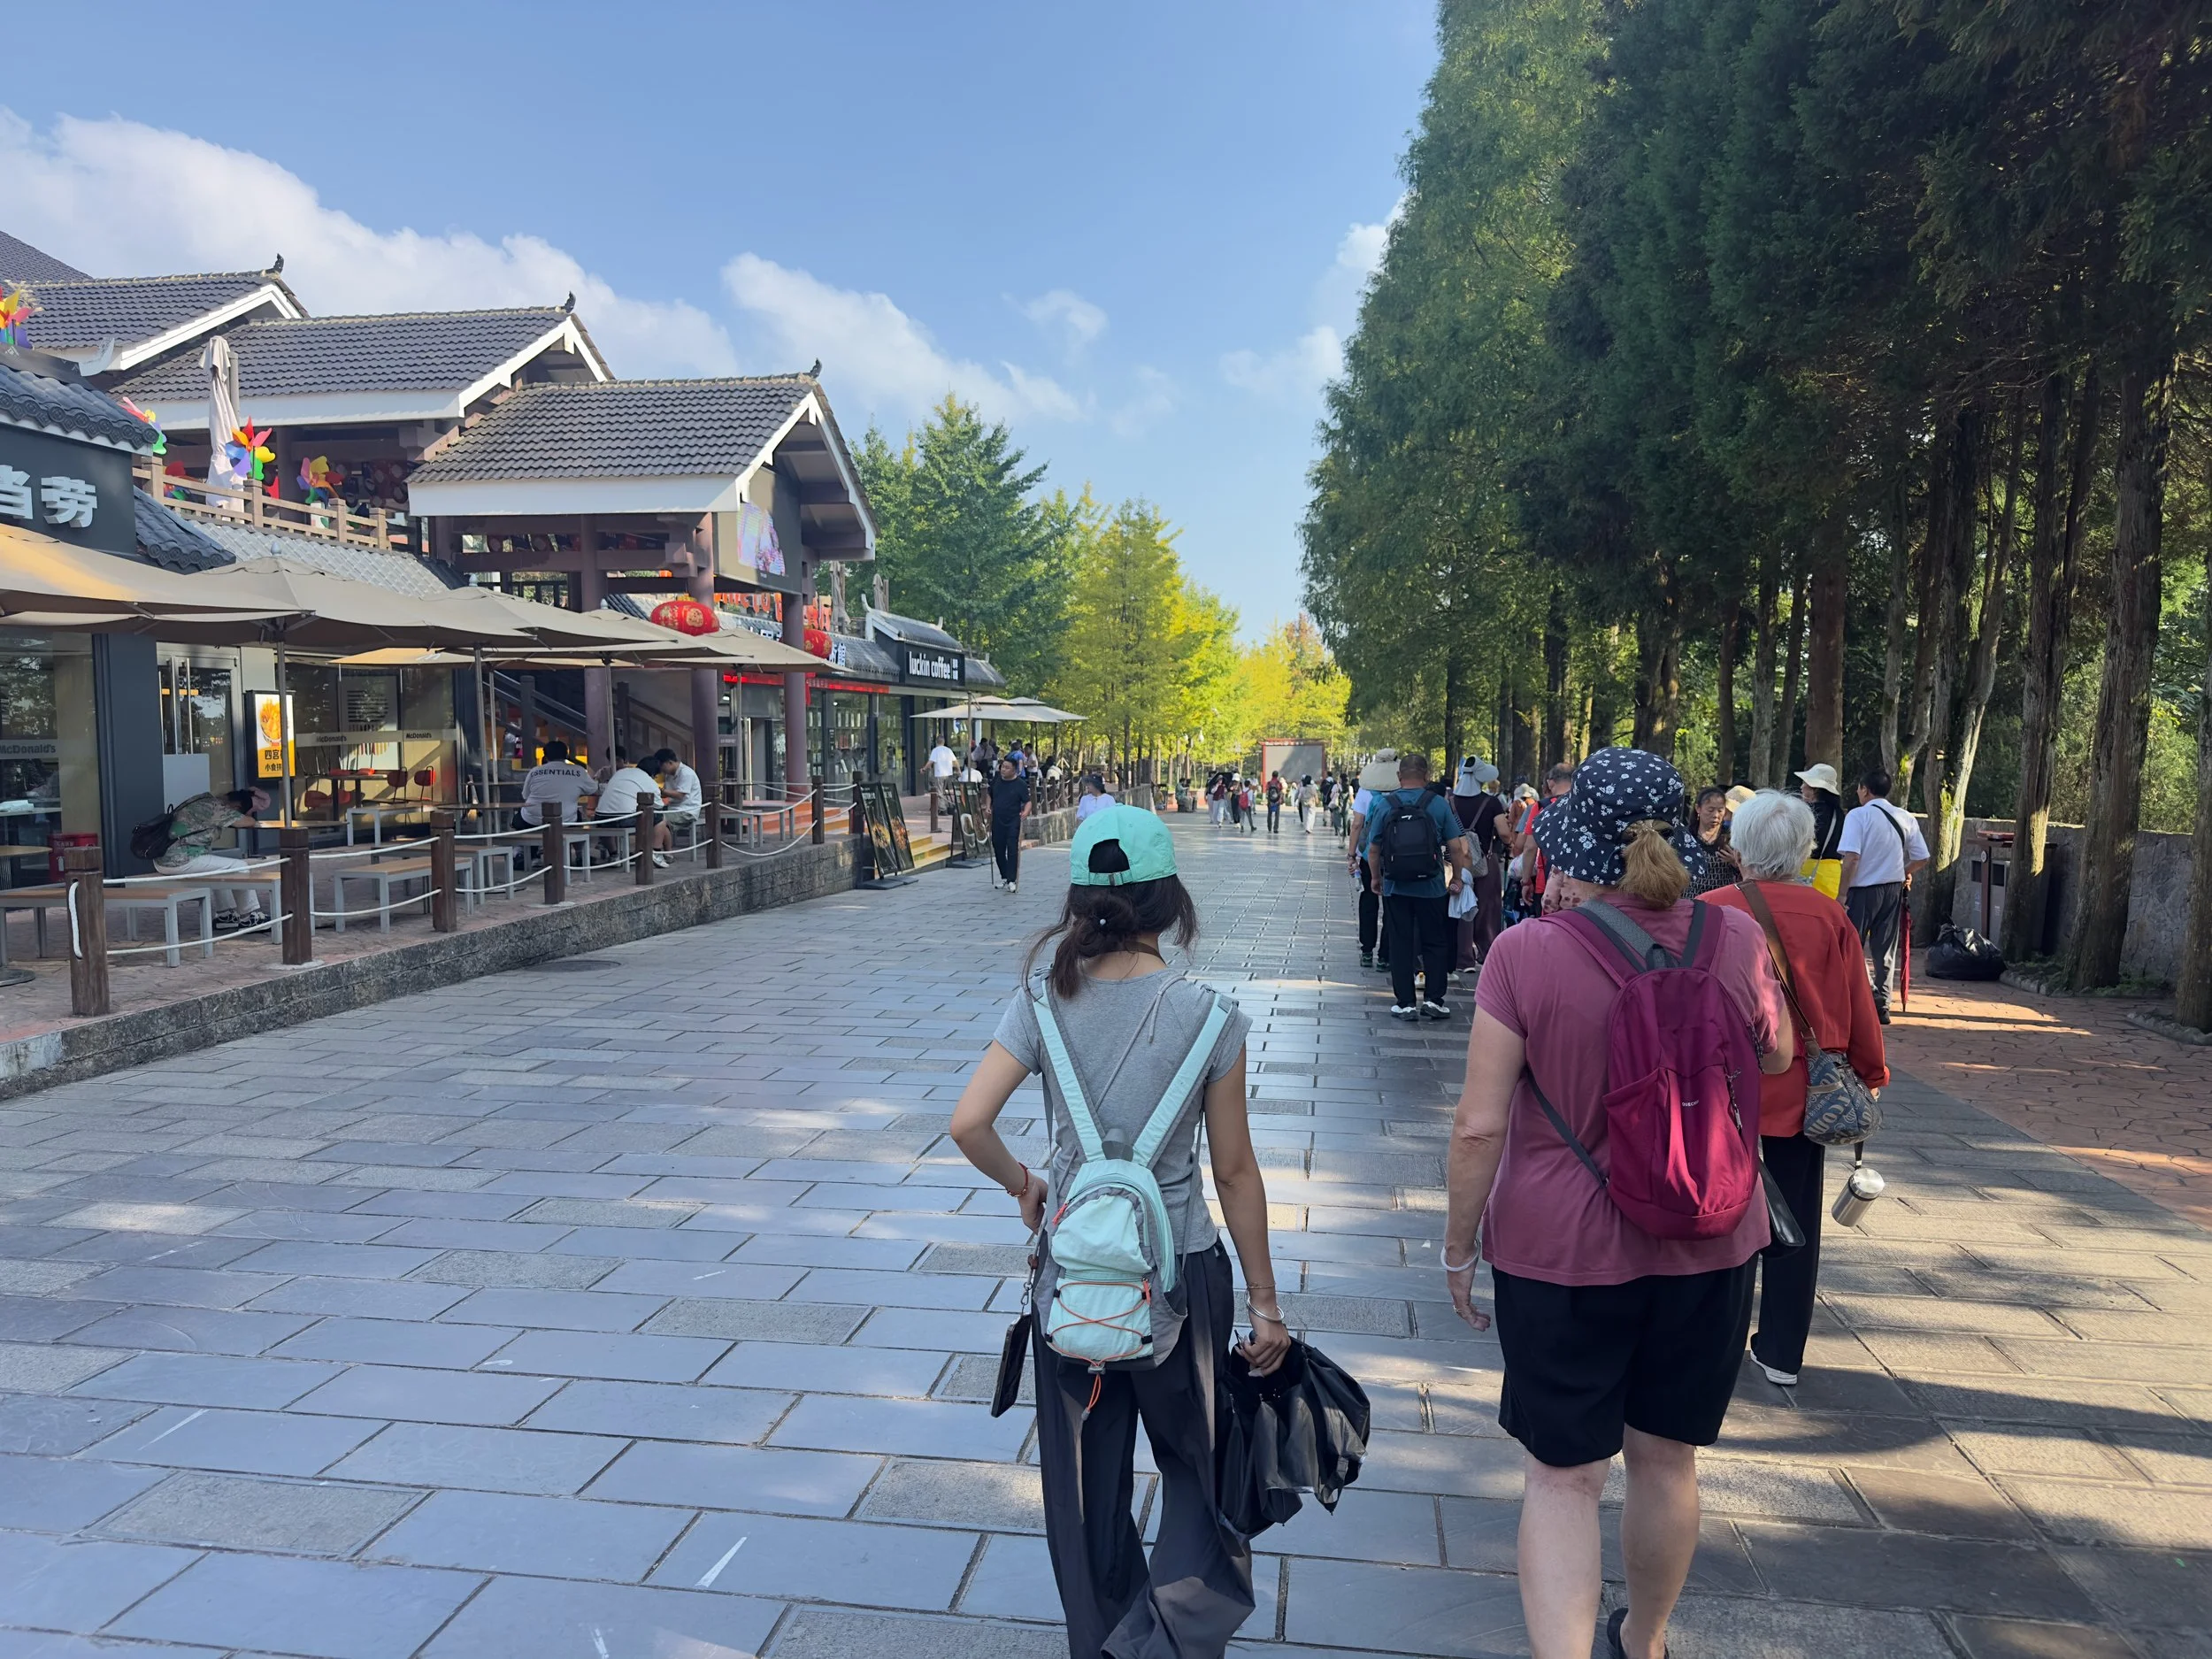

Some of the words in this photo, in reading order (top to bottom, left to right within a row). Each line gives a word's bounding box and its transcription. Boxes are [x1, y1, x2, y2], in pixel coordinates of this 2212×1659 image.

[909, 650, 930, 677] luckin
[931, 656, 950, 680] coffee
[316, 734, 347, 743] McDonald's
